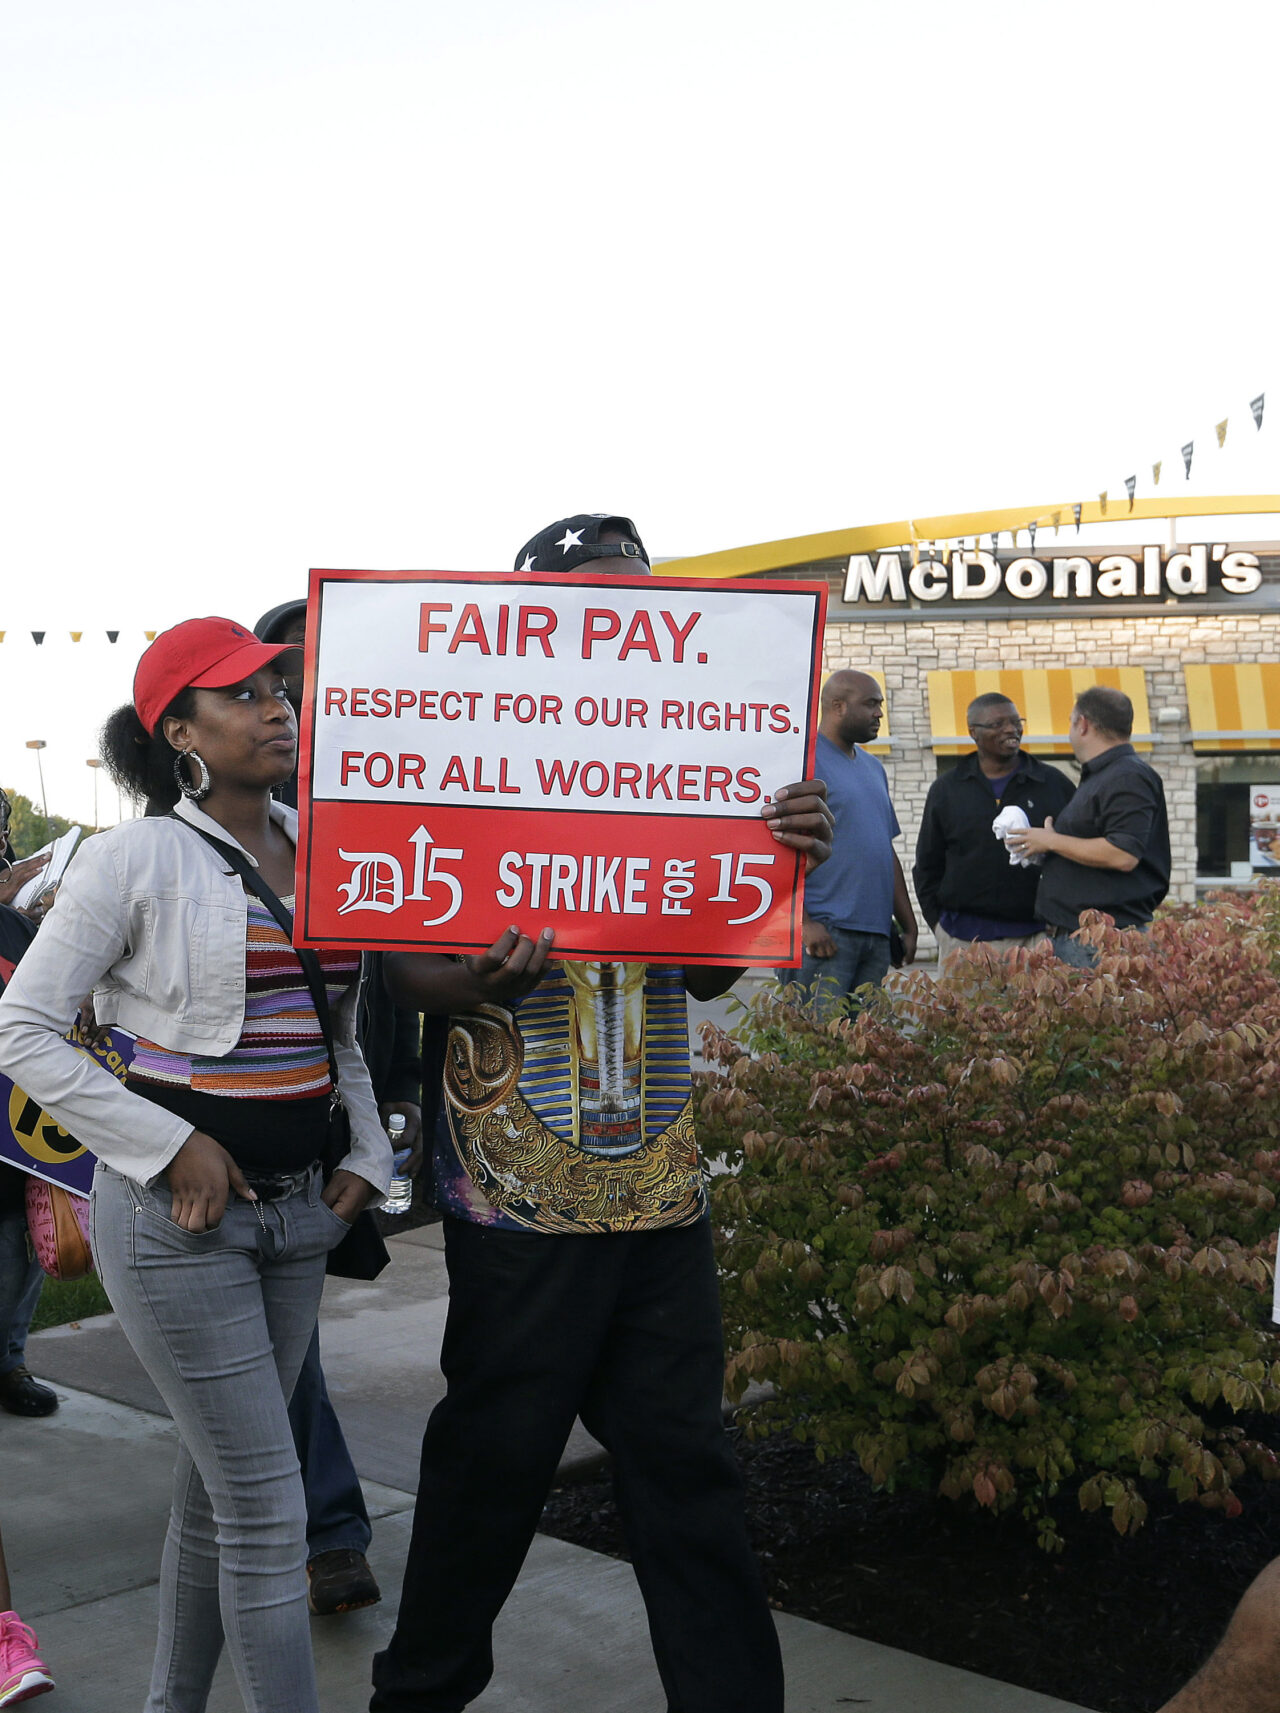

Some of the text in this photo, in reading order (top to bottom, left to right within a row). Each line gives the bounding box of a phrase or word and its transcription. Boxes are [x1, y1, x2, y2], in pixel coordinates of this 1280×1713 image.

[842, 543, 1263, 603] McDonald's
[418, 602, 708, 664] FAIR PAY.
[324, 687, 800, 734] RESPECT FOR OUR RIGHTS.
[340, 750, 772, 804] FOR ALL WORKERS.
[495, 851, 775, 925] STRIKE FOR 15
